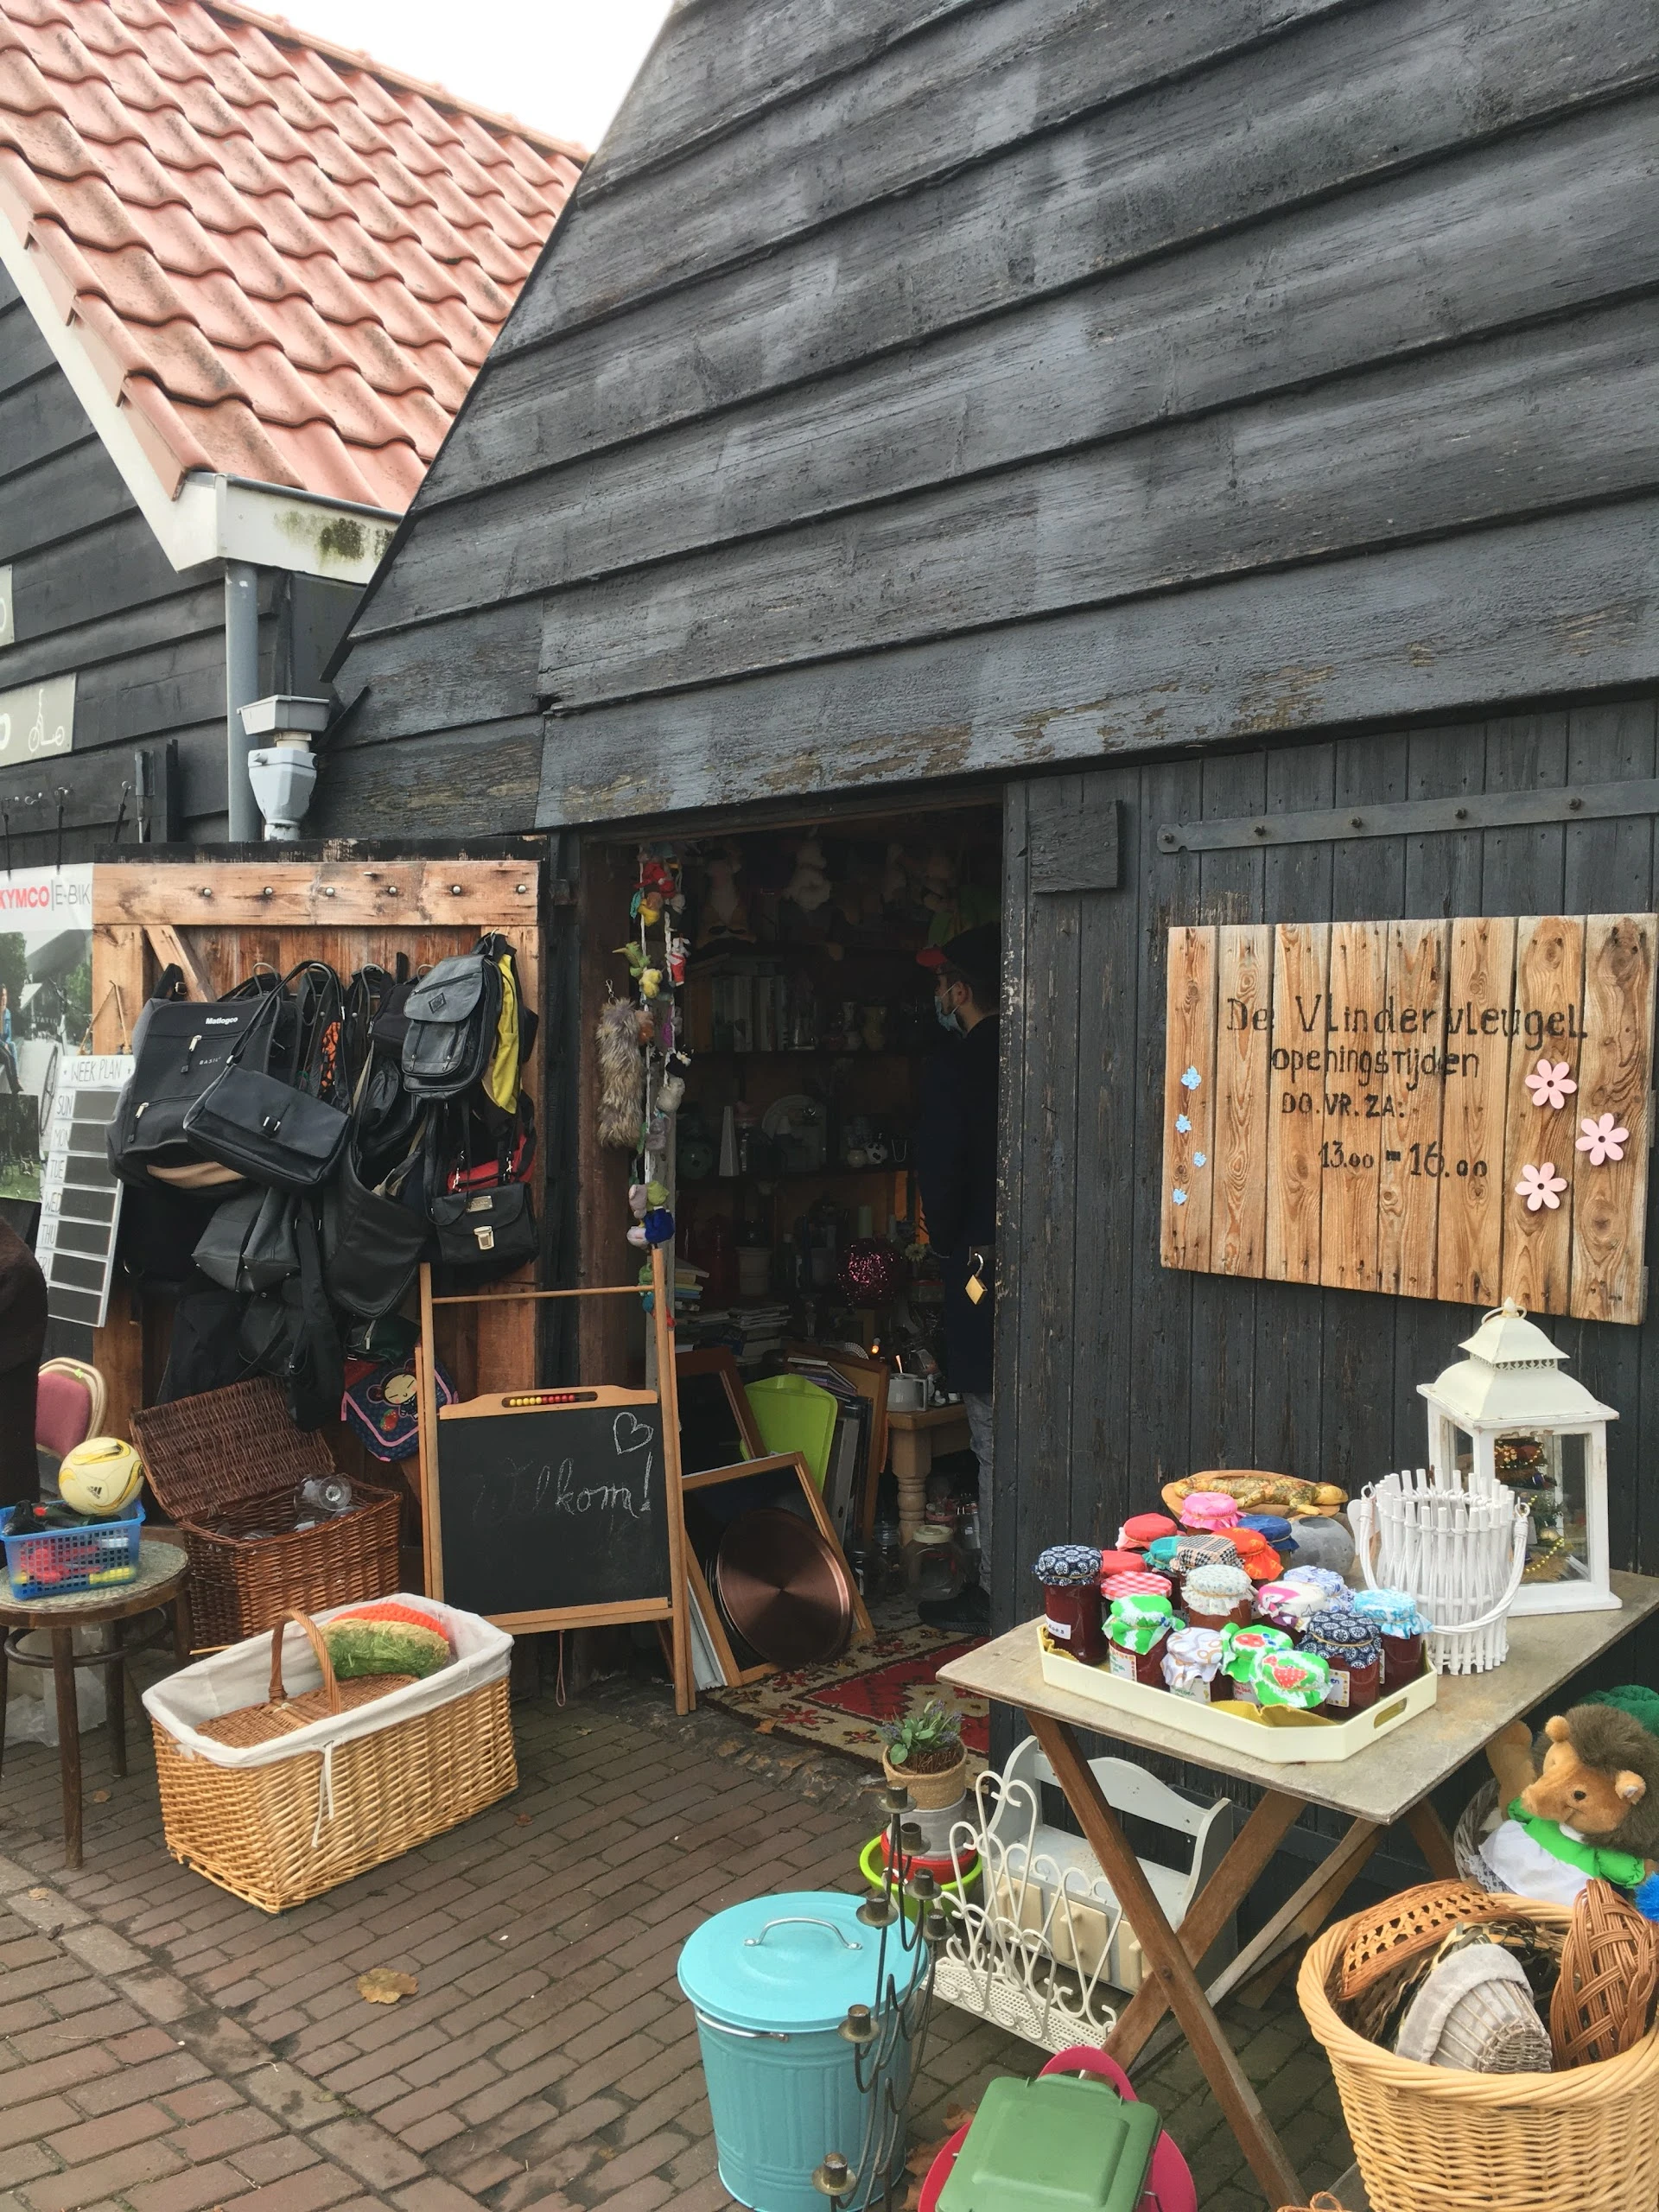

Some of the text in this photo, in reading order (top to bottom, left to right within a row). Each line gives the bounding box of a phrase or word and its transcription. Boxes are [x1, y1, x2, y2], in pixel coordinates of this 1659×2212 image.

[1227, 997, 1274, 1031] De
[71, 1058, 122, 1082] WEEK PLAN
[56, 1095, 74, 1116] SUN
[49, 1160, 66, 1179] TUE
[1318, 1140, 1375, 1168] 13.00
[1409, 1141, 1489, 1178] 16.00
[44, 1191, 62, 1213] WED
[41, 1224, 57, 1245] THU
